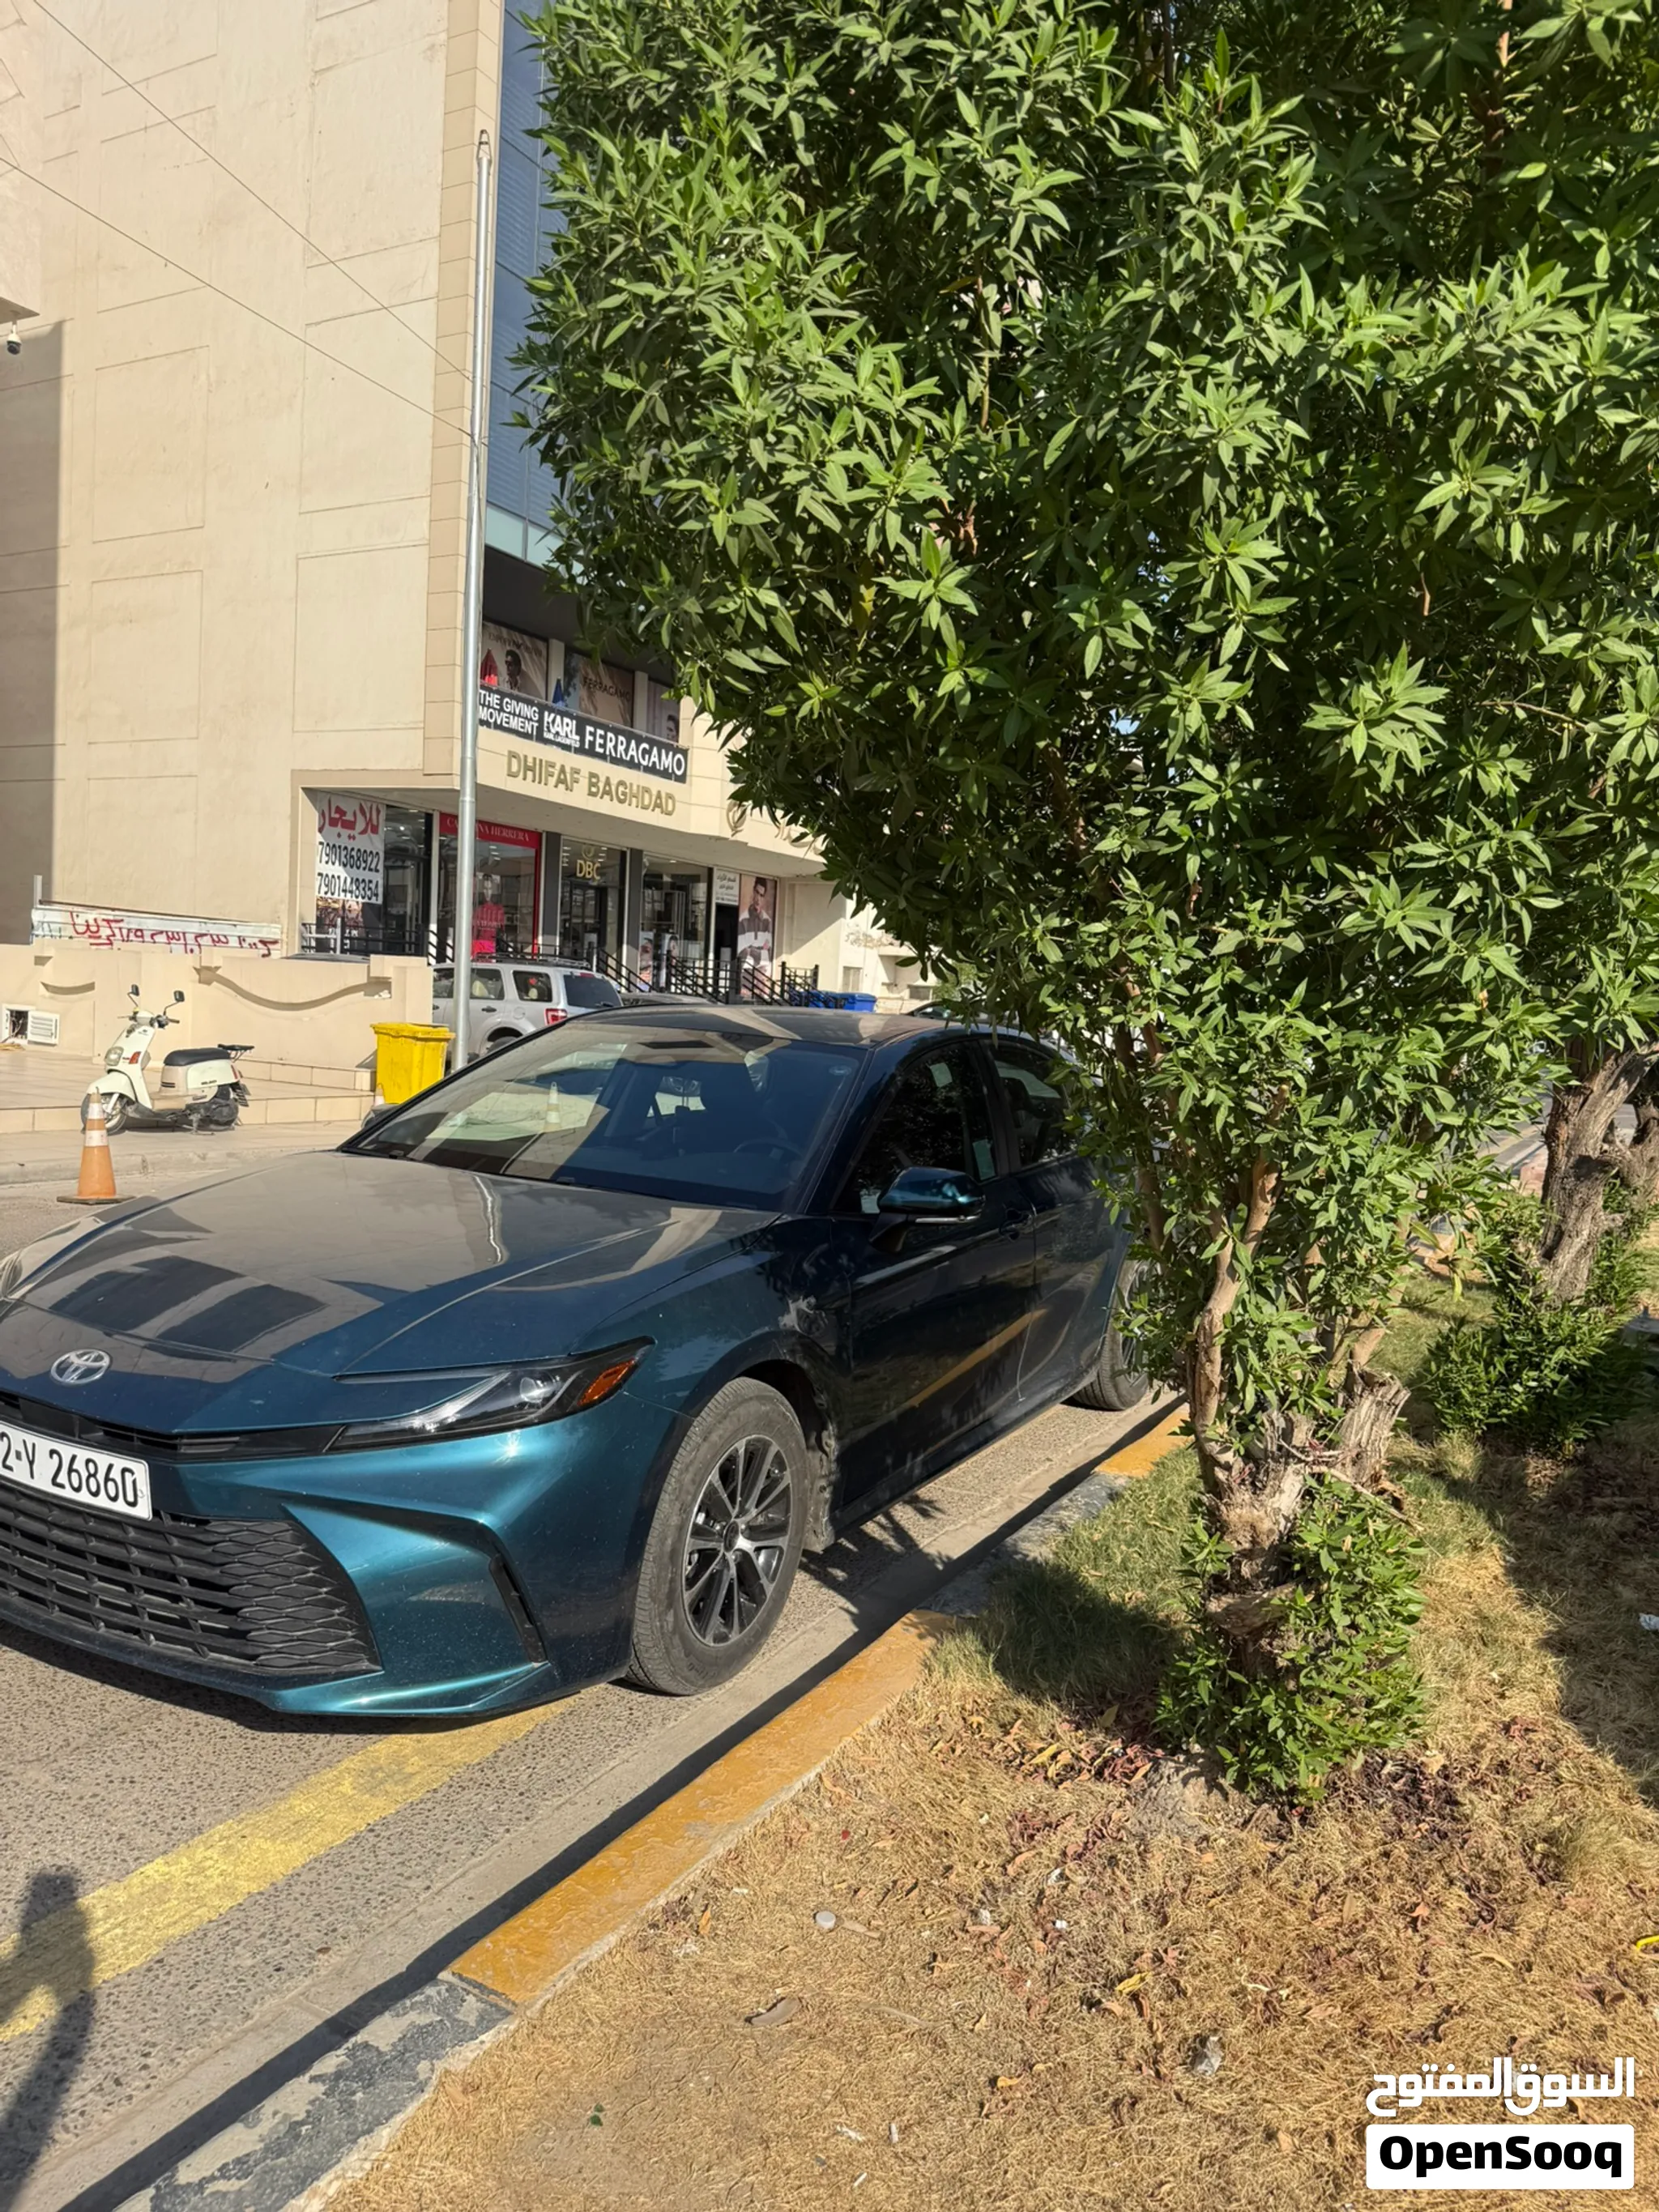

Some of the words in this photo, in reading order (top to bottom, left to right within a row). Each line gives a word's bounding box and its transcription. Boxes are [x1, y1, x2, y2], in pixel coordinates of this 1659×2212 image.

[480, 689, 501, 710] THE
[503, 697, 539, 721] GIVING
[480, 705, 539, 735] MOVEMENT
[544, 711, 580, 741] KARL
[584, 725, 685, 775] FERRAGAMO
[506, 749, 581, 792] DHIFAF
[587, 771, 676, 816] BAGHDAD
[318, 797, 381, 841] للايجار
[490, 825, 529, 842] HERRERA
[318, 842, 380, 873] 7901368922
[576, 859, 601, 880] DBC
[318, 872, 379, 901] 7901448354
[49, 1448, 139, 1507] 26860
